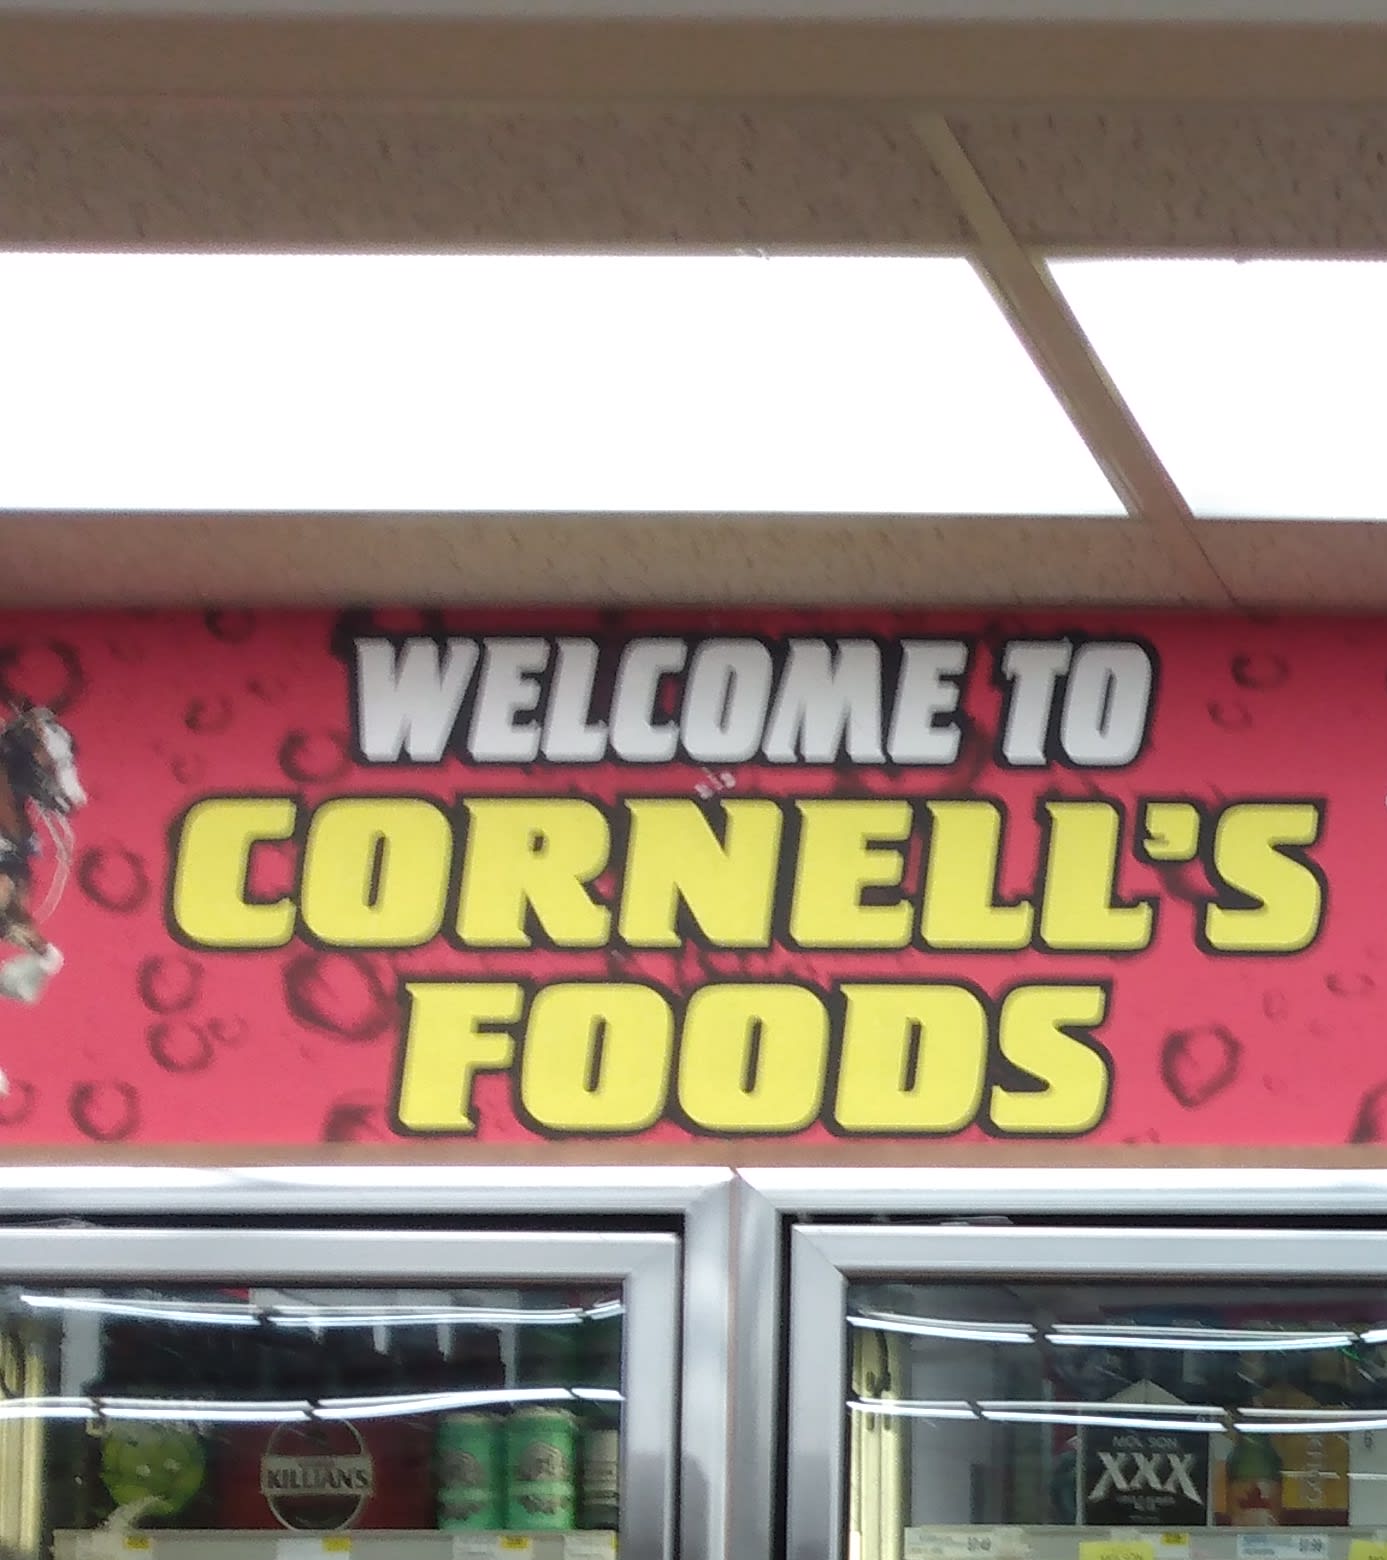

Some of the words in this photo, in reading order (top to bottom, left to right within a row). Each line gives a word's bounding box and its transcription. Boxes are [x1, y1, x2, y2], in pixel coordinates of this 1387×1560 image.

[352, 635, 976, 764] WELCOME
[1000, 637, 1157, 766] TO
[170, 795, 1328, 953] CORNELL'S
[396, 977, 1113, 1139] FOODS
[1088, 1451, 1204, 1505] XXX
